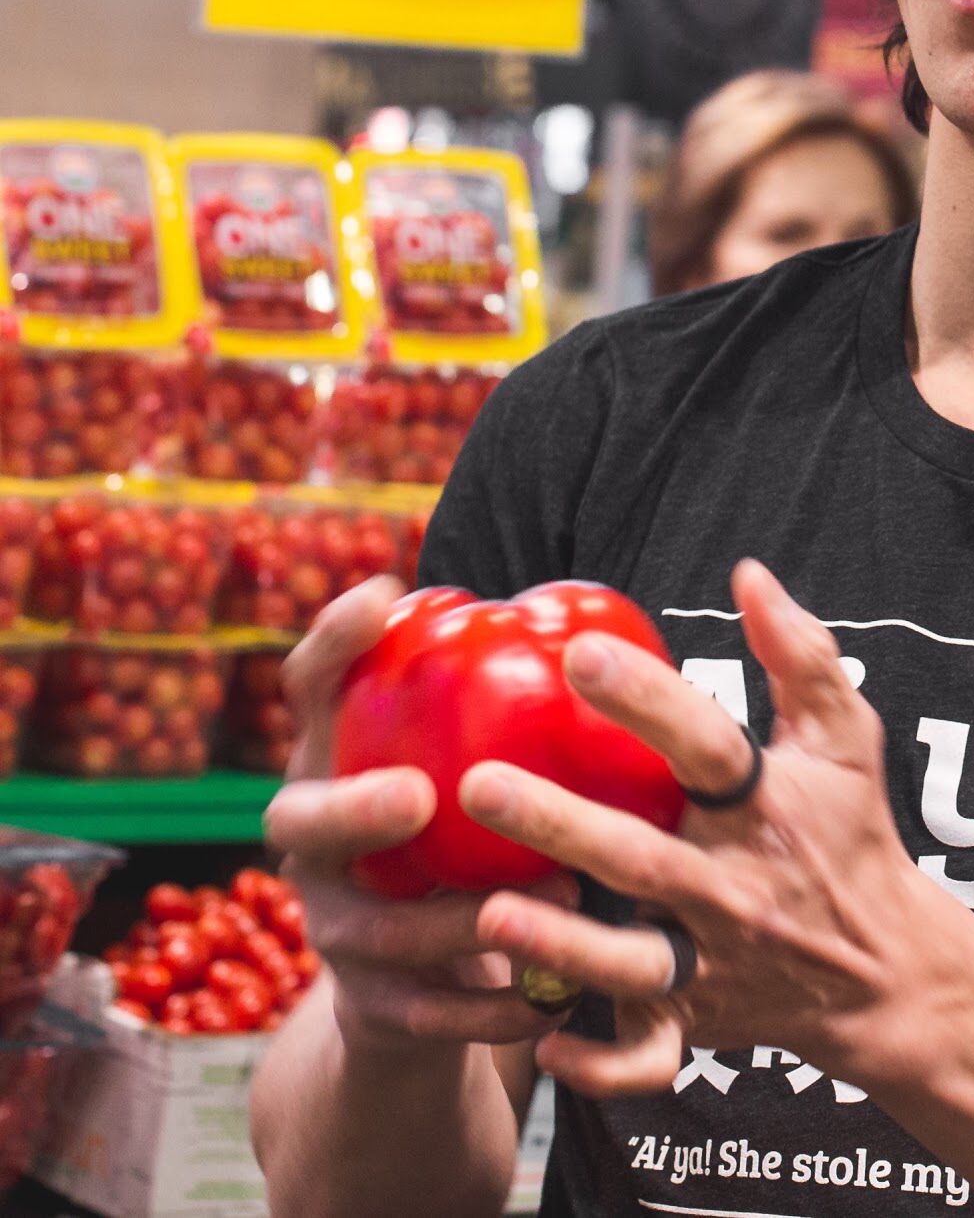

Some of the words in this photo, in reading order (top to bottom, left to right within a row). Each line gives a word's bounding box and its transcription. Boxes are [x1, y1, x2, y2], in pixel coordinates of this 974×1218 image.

[670, 1138, 713, 1185] ya!
[717, 1138, 783, 1181] She
[791, 1147, 892, 1189] stole
[900, 1161, 971, 1207] my
